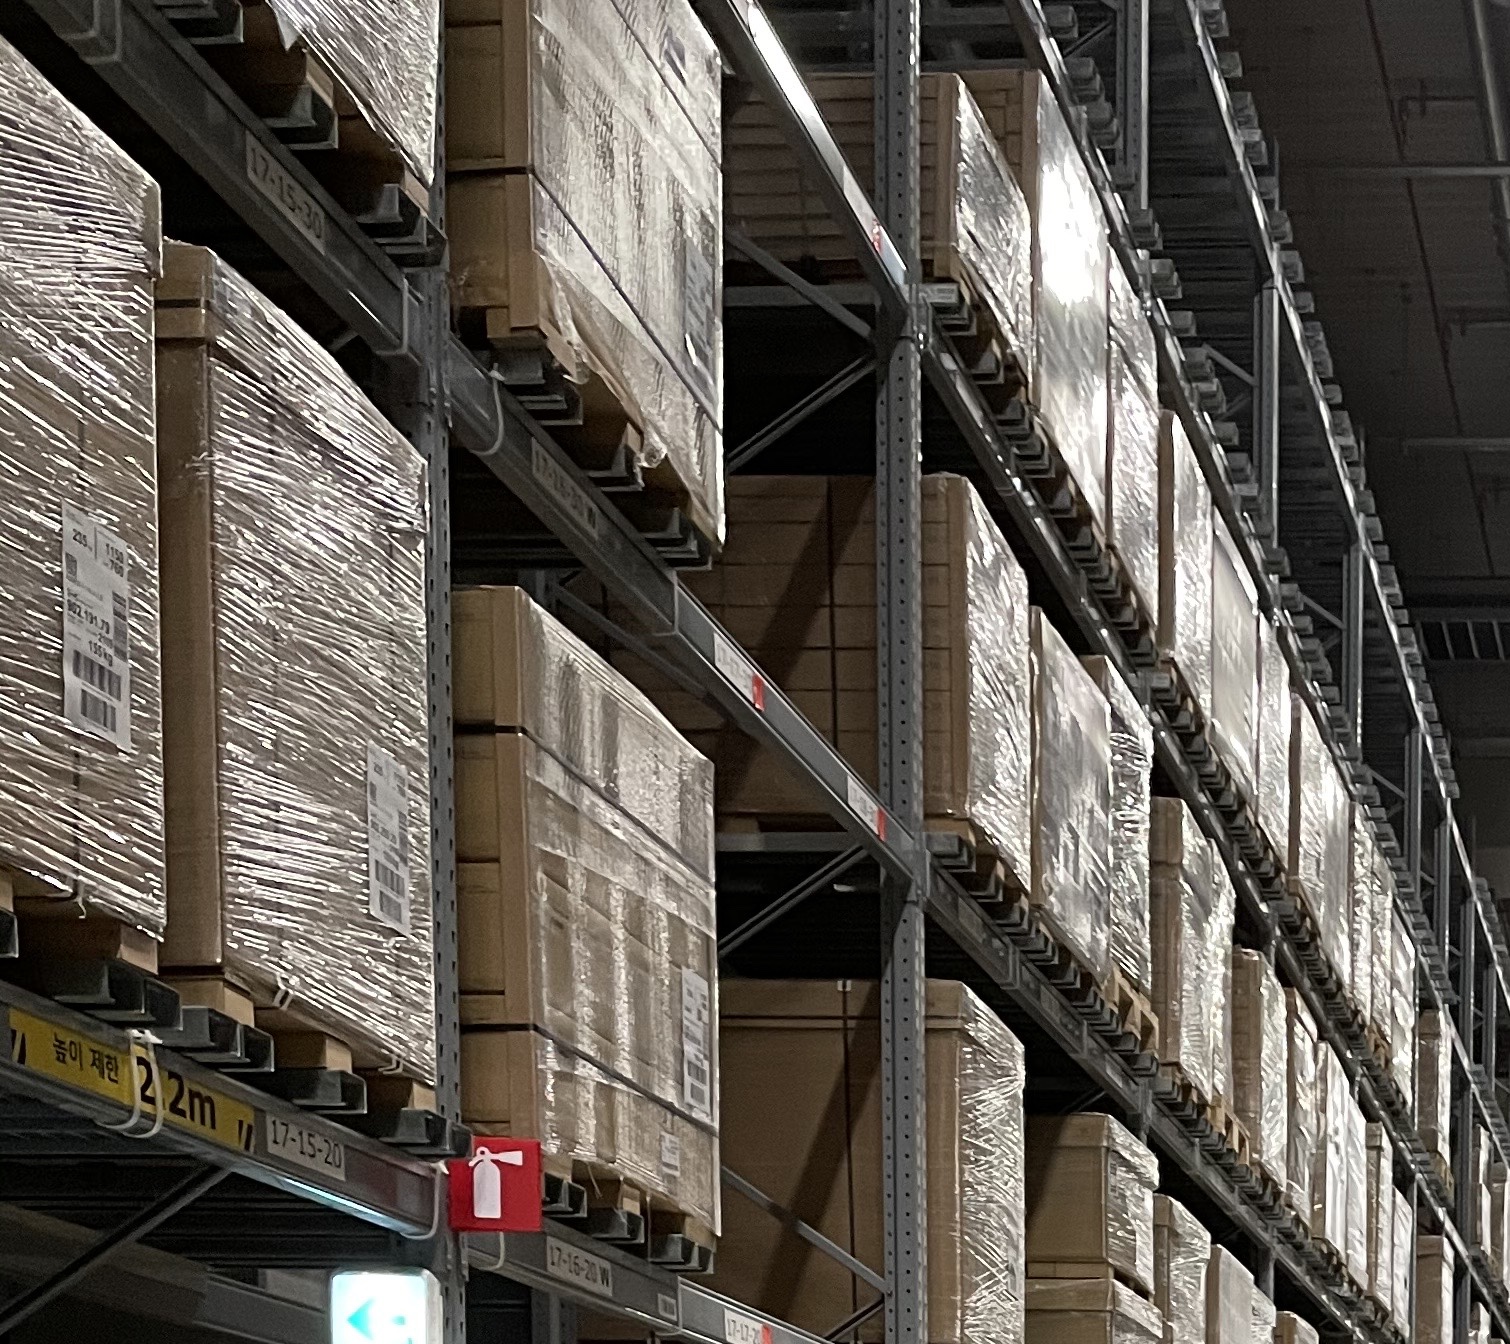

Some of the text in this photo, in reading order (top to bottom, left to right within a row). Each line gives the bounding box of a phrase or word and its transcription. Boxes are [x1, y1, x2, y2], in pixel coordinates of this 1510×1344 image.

[53, 1031, 83, 1071] 높이
[90, 1048, 119, 1085] 제한
[270, 1118, 343, 1170] 17-15-20
